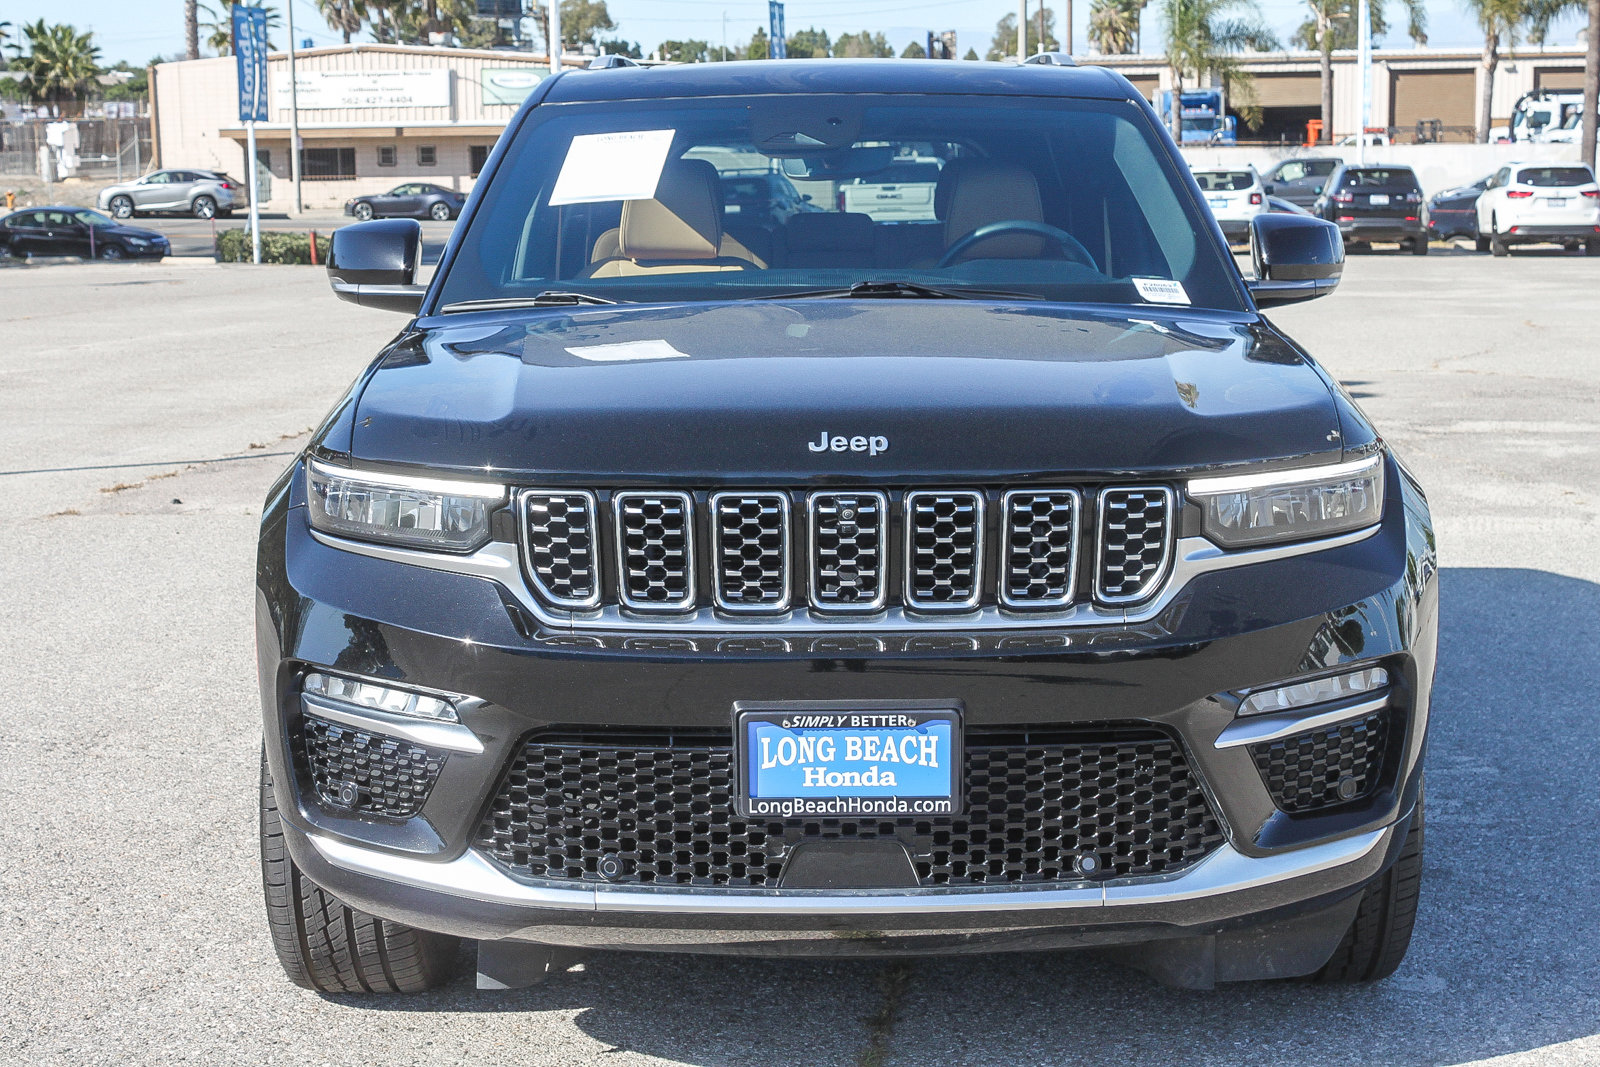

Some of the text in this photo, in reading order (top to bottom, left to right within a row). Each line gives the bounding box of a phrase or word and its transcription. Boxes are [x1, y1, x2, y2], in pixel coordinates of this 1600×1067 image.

[238, 22, 254, 115] Honda
[808, 431, 889, 456] Jeep
[791, 714, 907, 728] SIMPLY BETTER
[761, 735, 939, 770] LONG BEACH
[802, 765, 897, 787] Honda
[749, 795, 952, 817] LongBeachHonda.com
